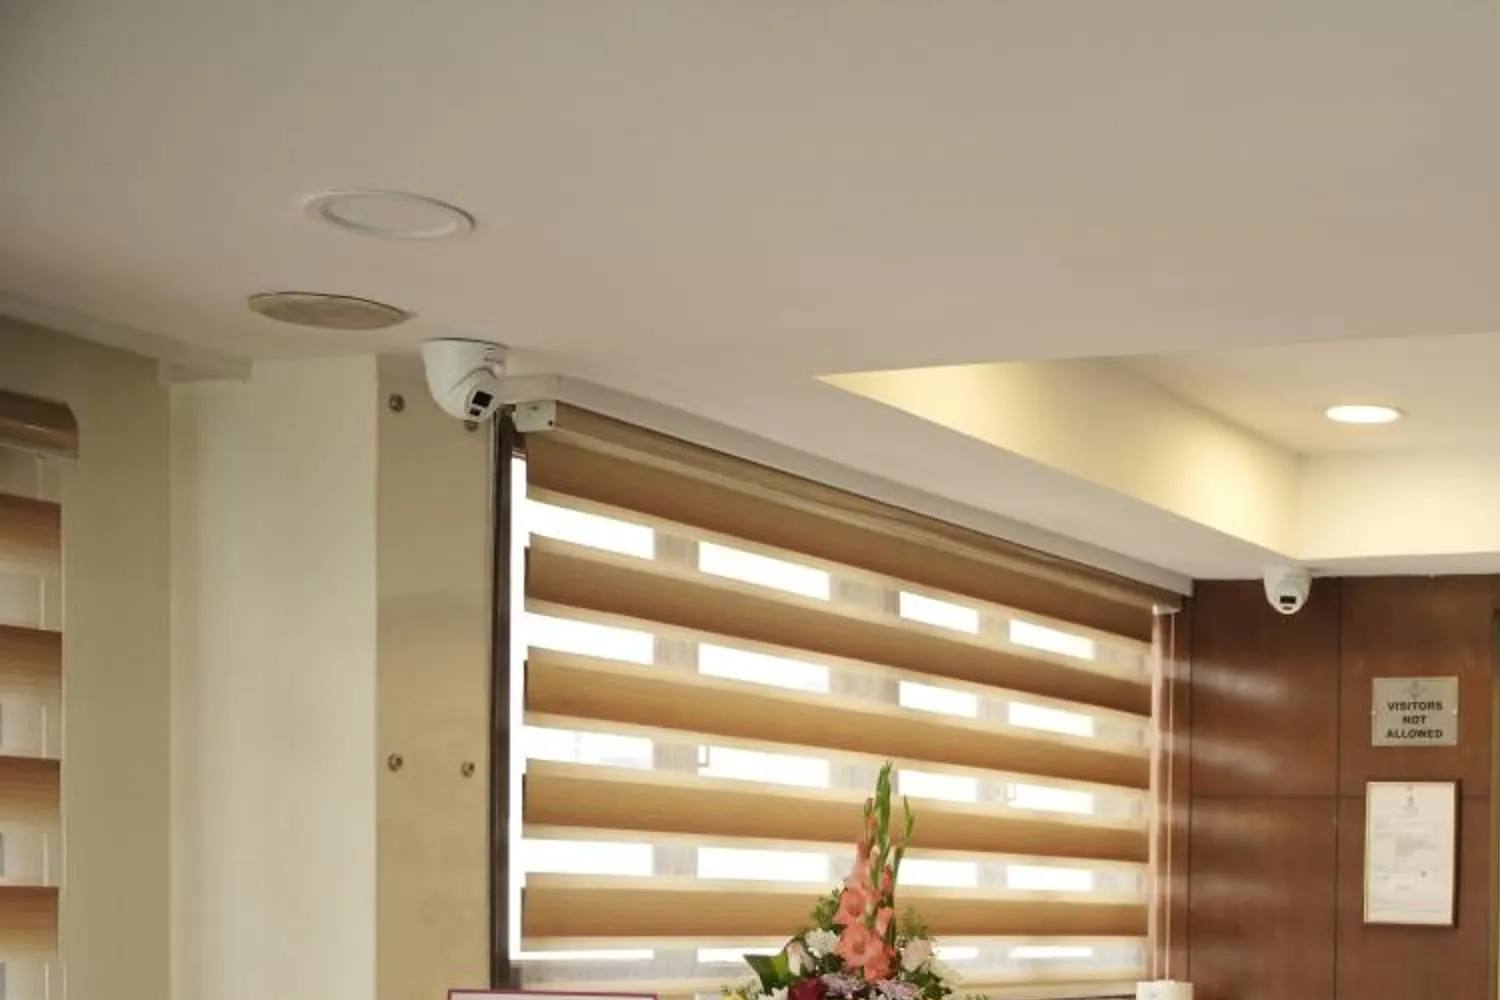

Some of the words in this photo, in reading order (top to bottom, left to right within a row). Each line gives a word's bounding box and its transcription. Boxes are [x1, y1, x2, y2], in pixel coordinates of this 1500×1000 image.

[1387, 701, 1443, 711] VISITORS
[1402, 715, 1426, 725] NOT
[1386, 729, 1443, 739] ALLOWED
